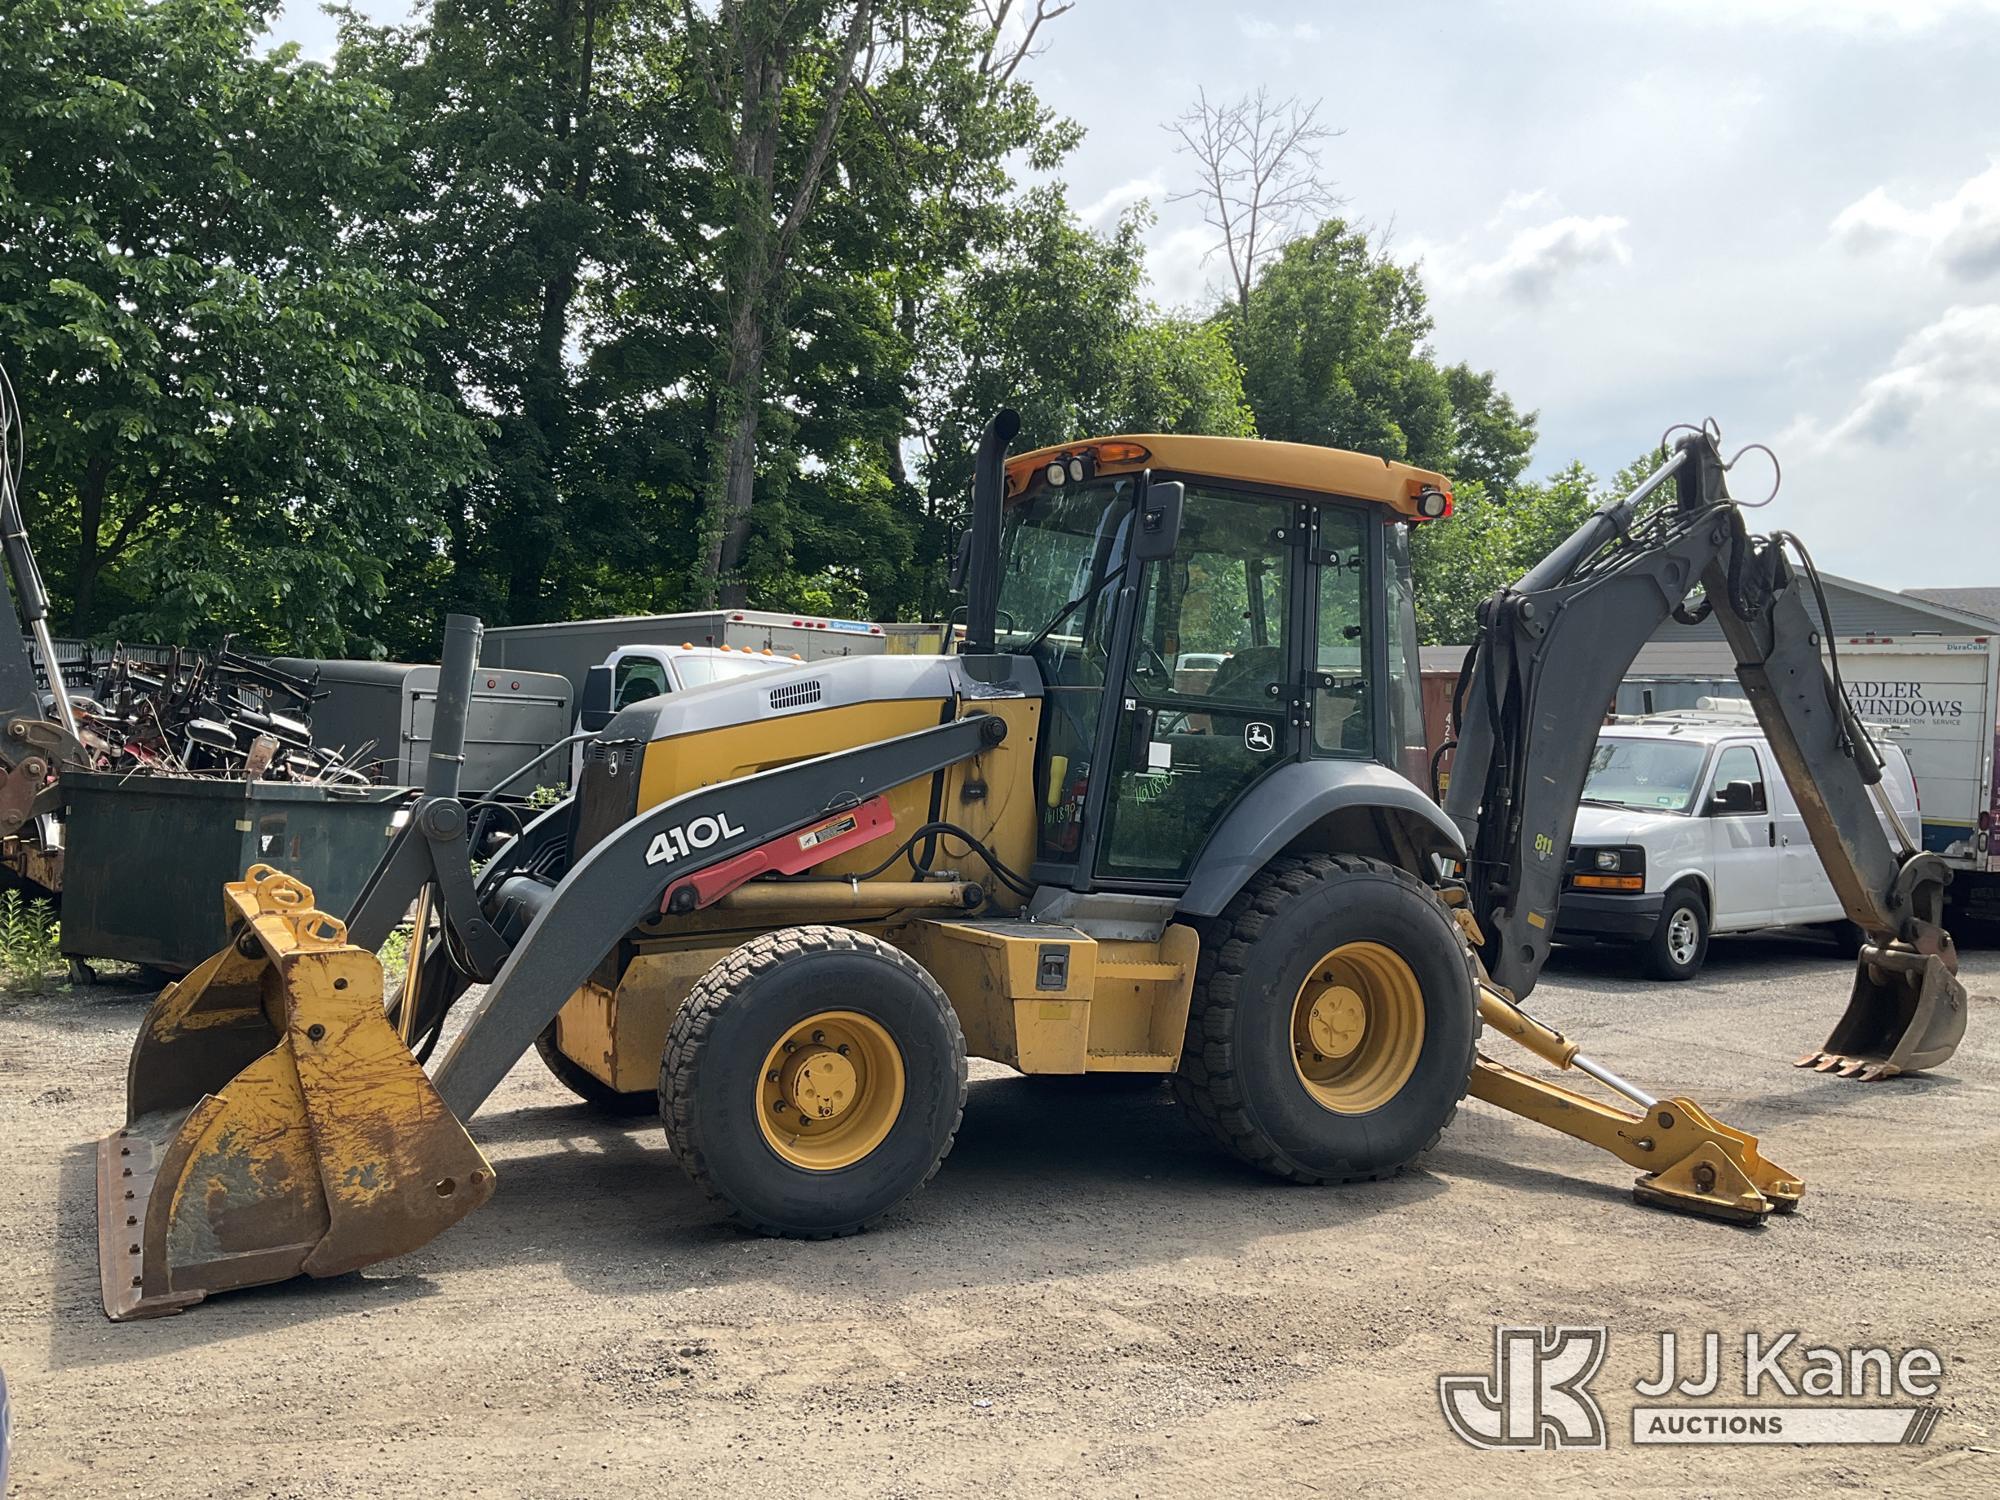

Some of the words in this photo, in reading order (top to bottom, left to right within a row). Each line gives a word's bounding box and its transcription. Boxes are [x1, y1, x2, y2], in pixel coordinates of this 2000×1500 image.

[1849, 682, 1922, 698] ADLER
[1850, 700, 1962, 717] WINDOWS
[645, 813, 745, 866] 410L
[1535, 834, 1552, 855] 811
